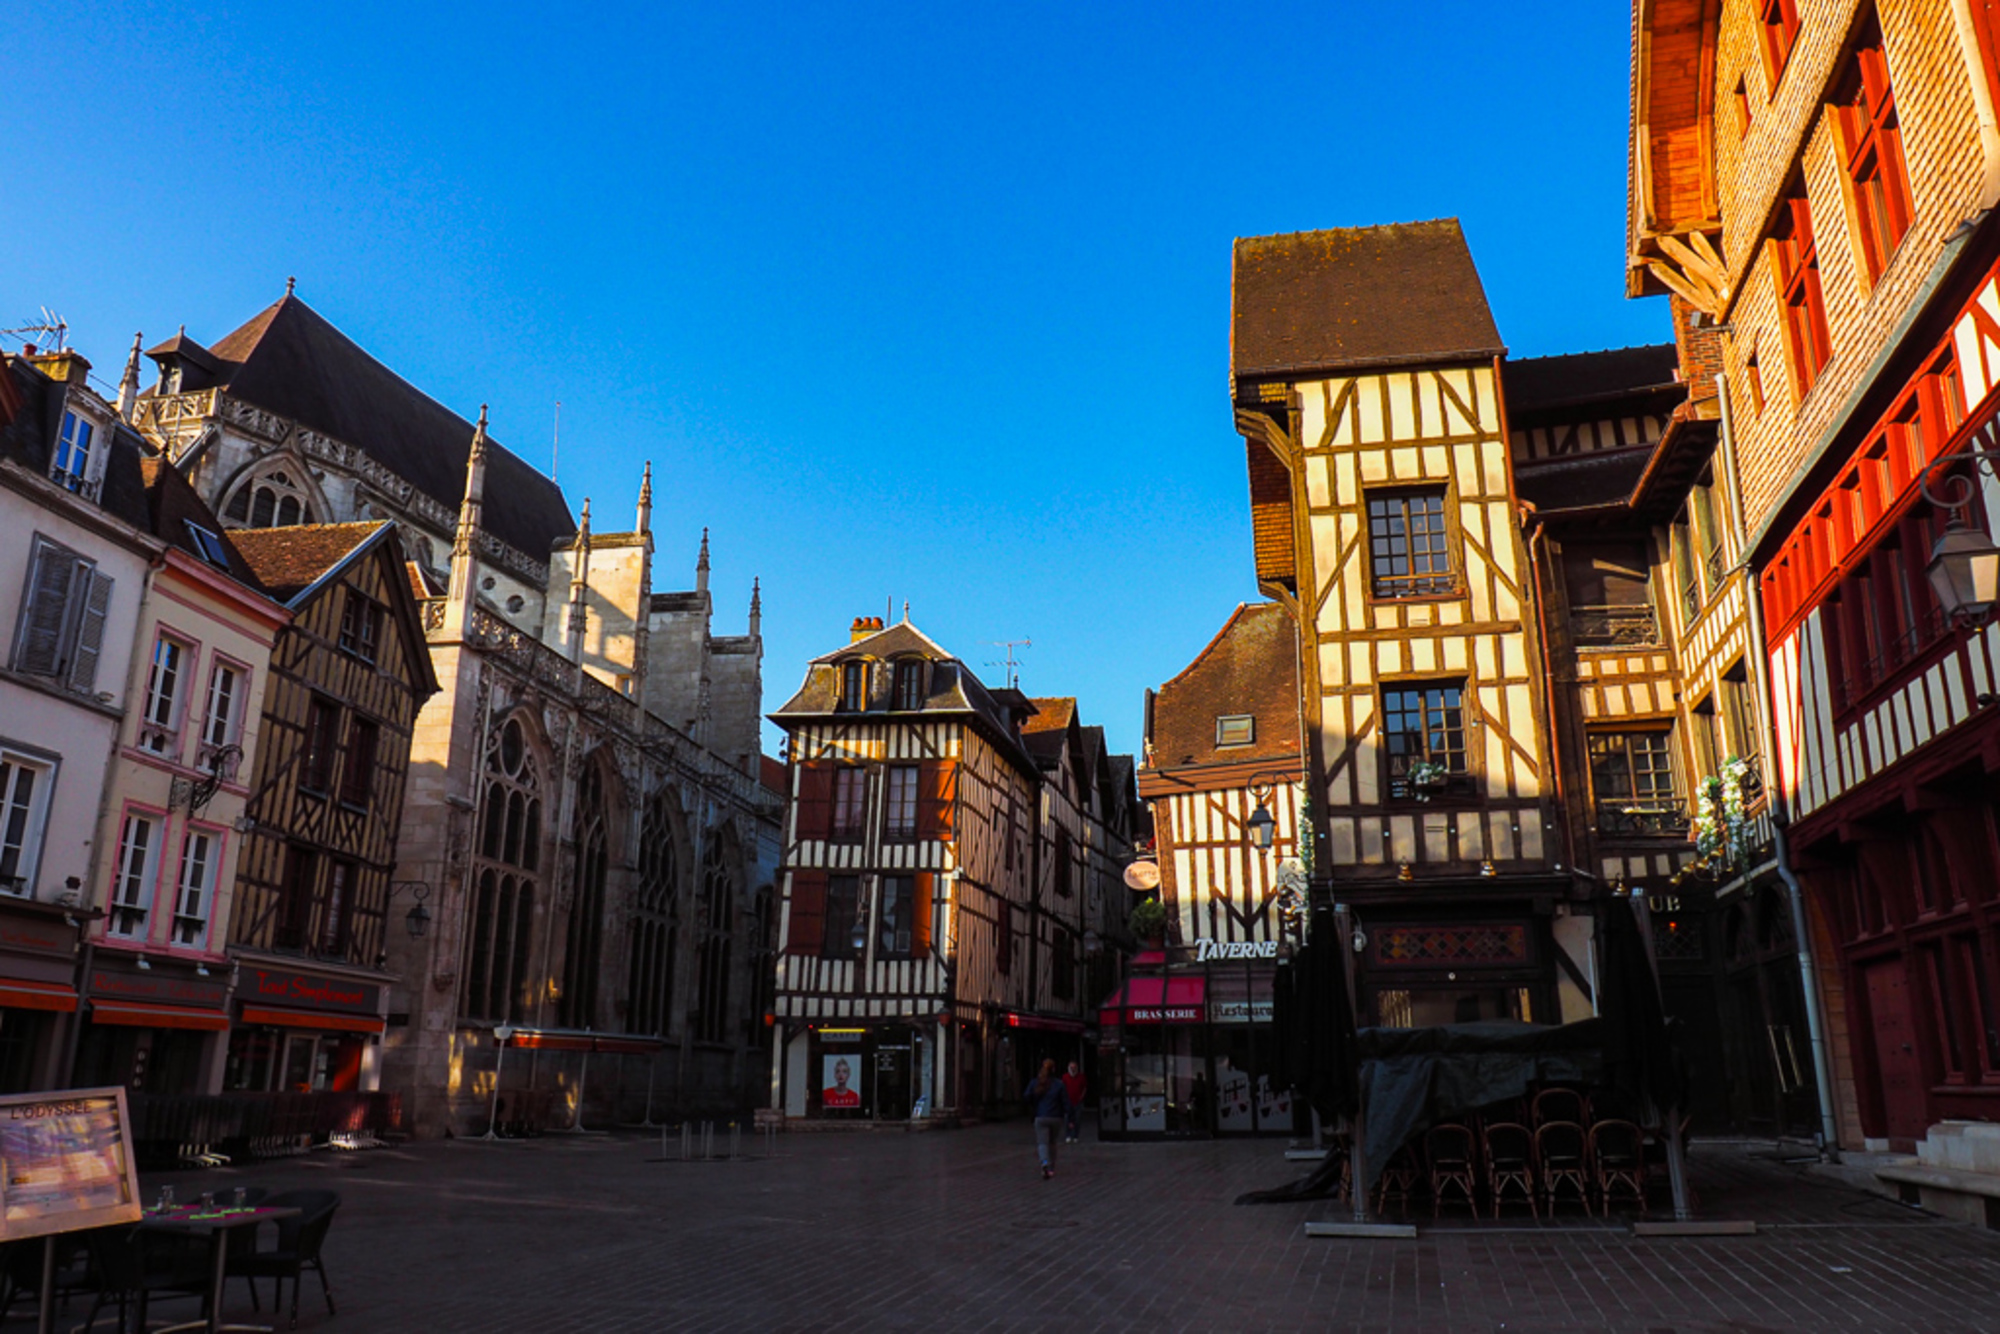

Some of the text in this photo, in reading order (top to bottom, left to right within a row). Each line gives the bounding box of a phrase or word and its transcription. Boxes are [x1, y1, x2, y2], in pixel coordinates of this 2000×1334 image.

[1649, 895, 1681, 913] UB
[1195, 938, 1277, 962] TAVERNE
[290, 976, 363, 1006] Simplement
[1133, 1008, 1197, 1020] BRASSERIE
[1213, 1003, 1273, 1019] Restaura
